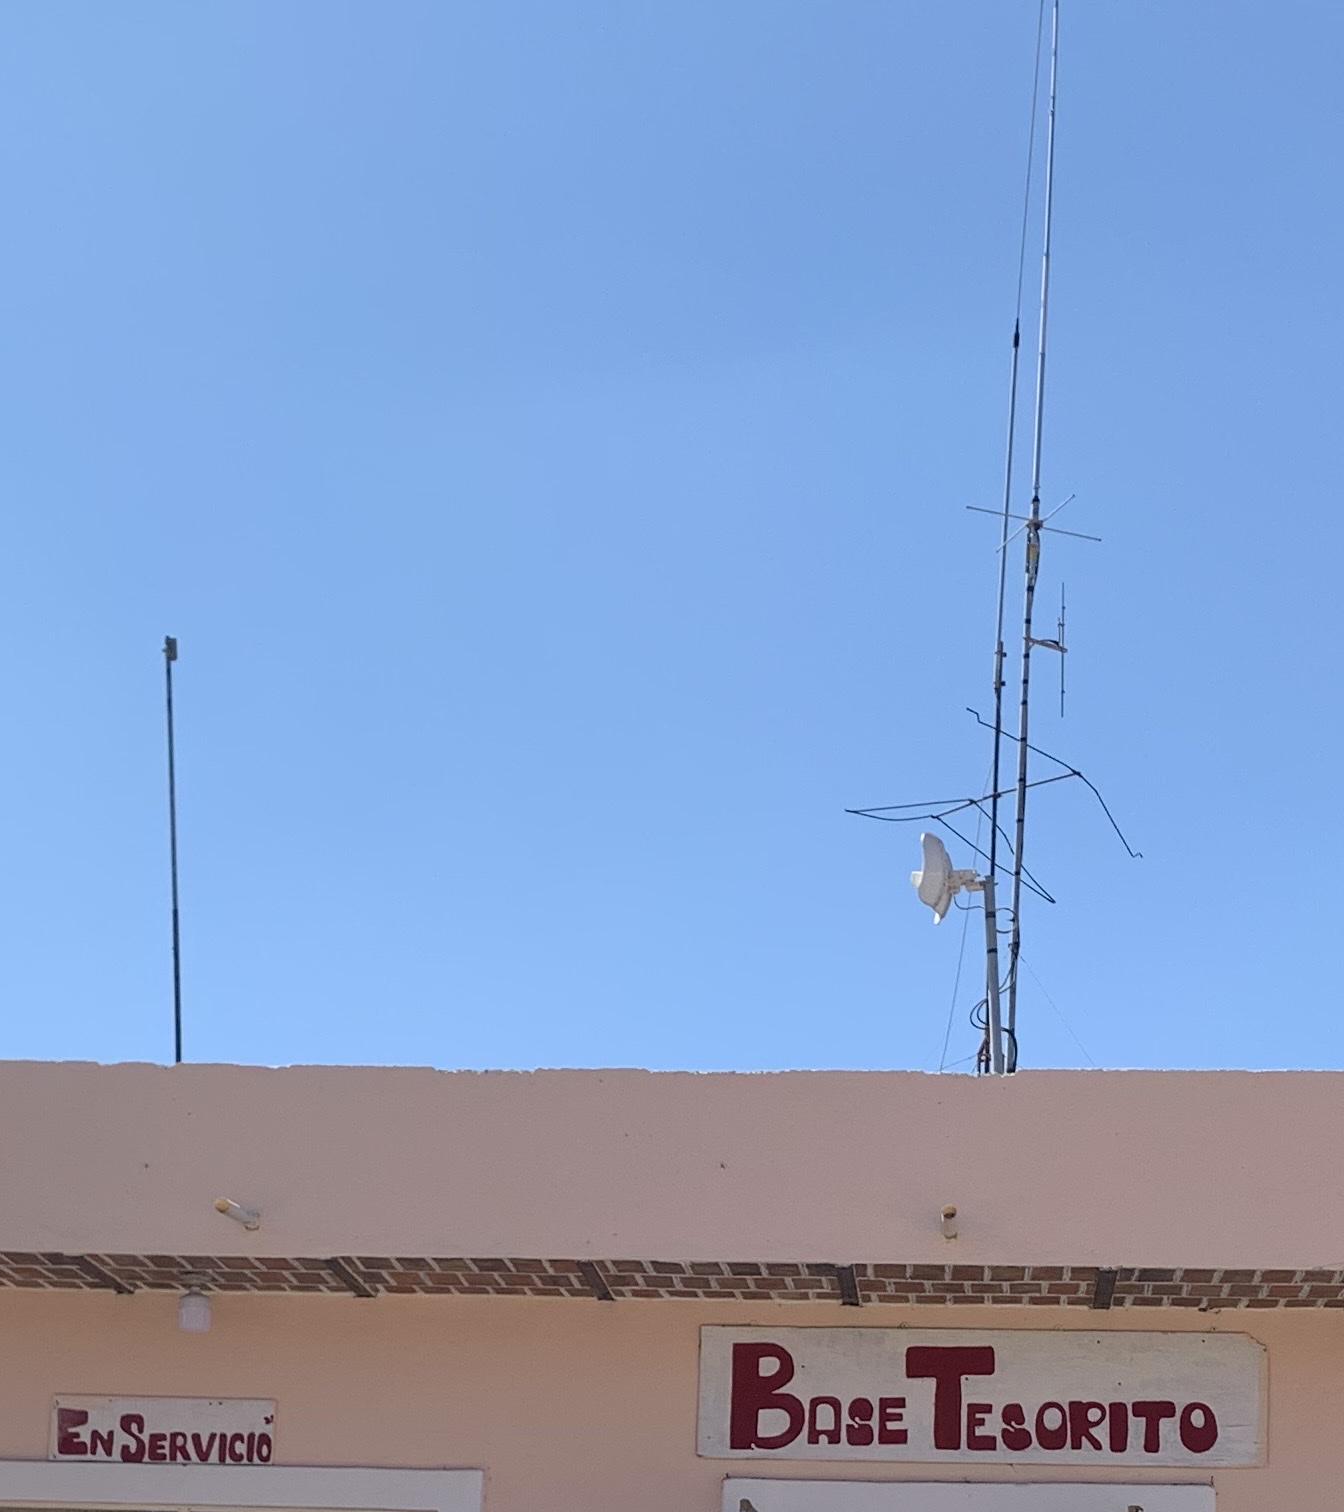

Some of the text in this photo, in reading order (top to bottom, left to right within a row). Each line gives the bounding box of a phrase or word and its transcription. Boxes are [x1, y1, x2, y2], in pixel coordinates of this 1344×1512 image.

[57, 1407, 272, 1463] EN SERVICIO
[728, 1342, 1218, 1454] BASE TESORITO
